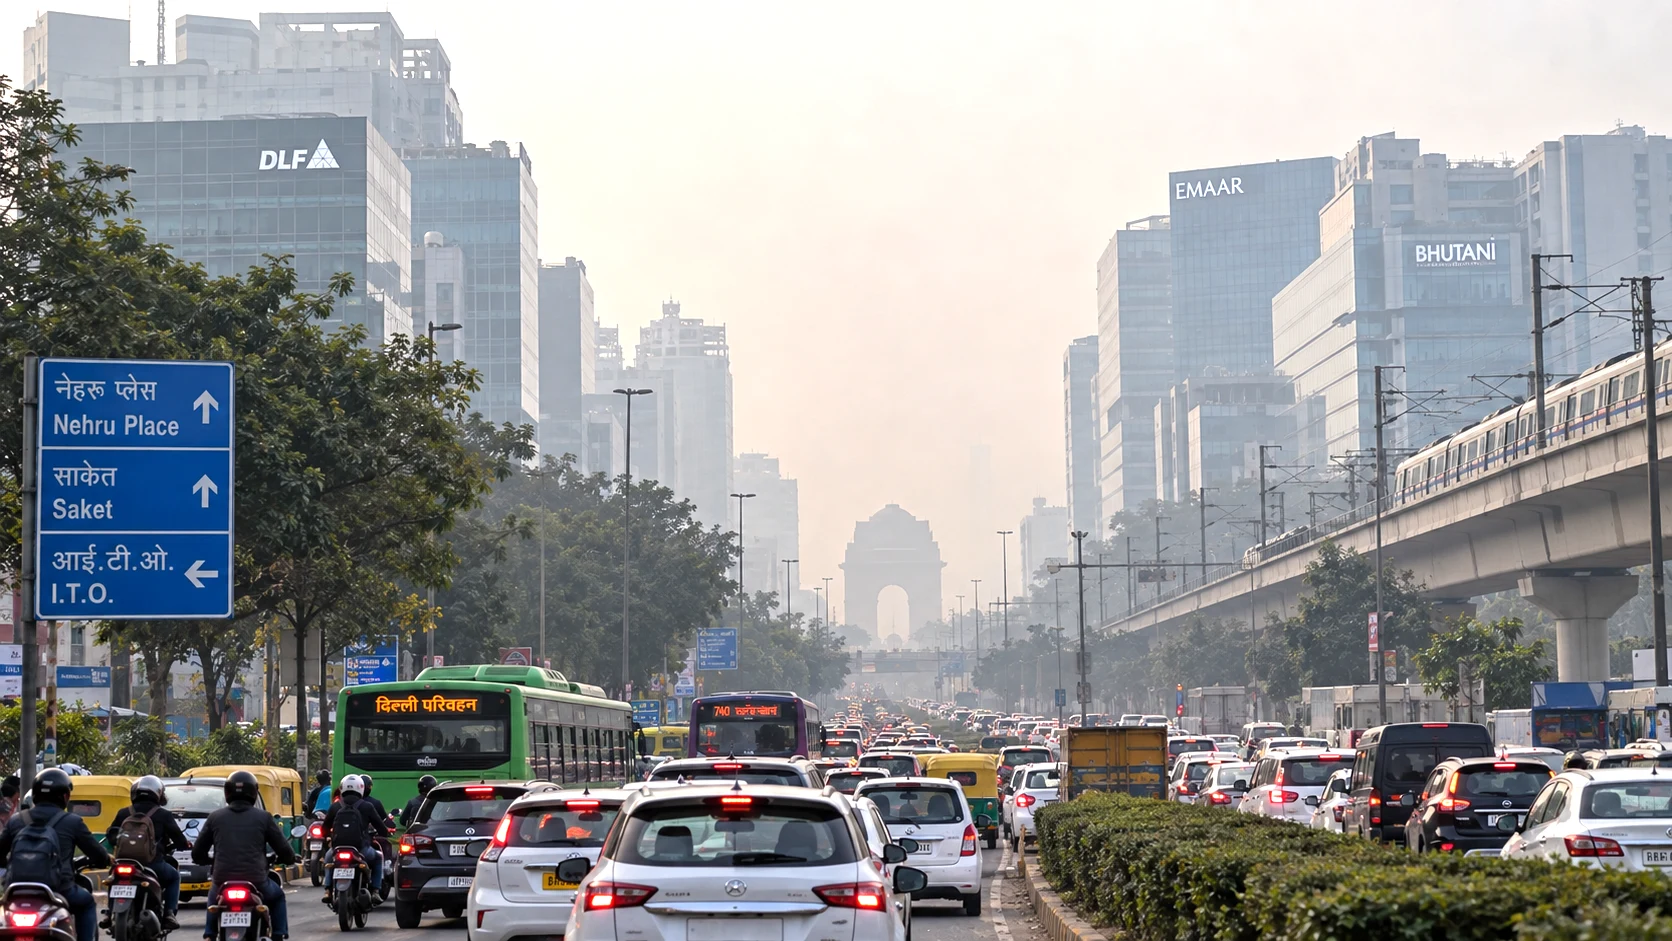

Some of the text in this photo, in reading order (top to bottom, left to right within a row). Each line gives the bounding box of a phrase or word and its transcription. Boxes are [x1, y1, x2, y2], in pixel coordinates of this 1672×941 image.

[259, 149, 308, 170] DLF
[1175, 177, 1244, 200] EMAAR
[54, 372, 157, 402] नेहरू प्लेस
[53, 414, 180, 436] Nehru Place
[53, 460, 118, 487] साकेत
[52, 498, 114, 520] Saket
[52, 543, 174, 575] आई.टी.ओ.
[51, 582, 114, 604] I.T.O.
[375, 694, 478, 713] दिल्ली परिवहन
[713, 706, 731, 717] 740
